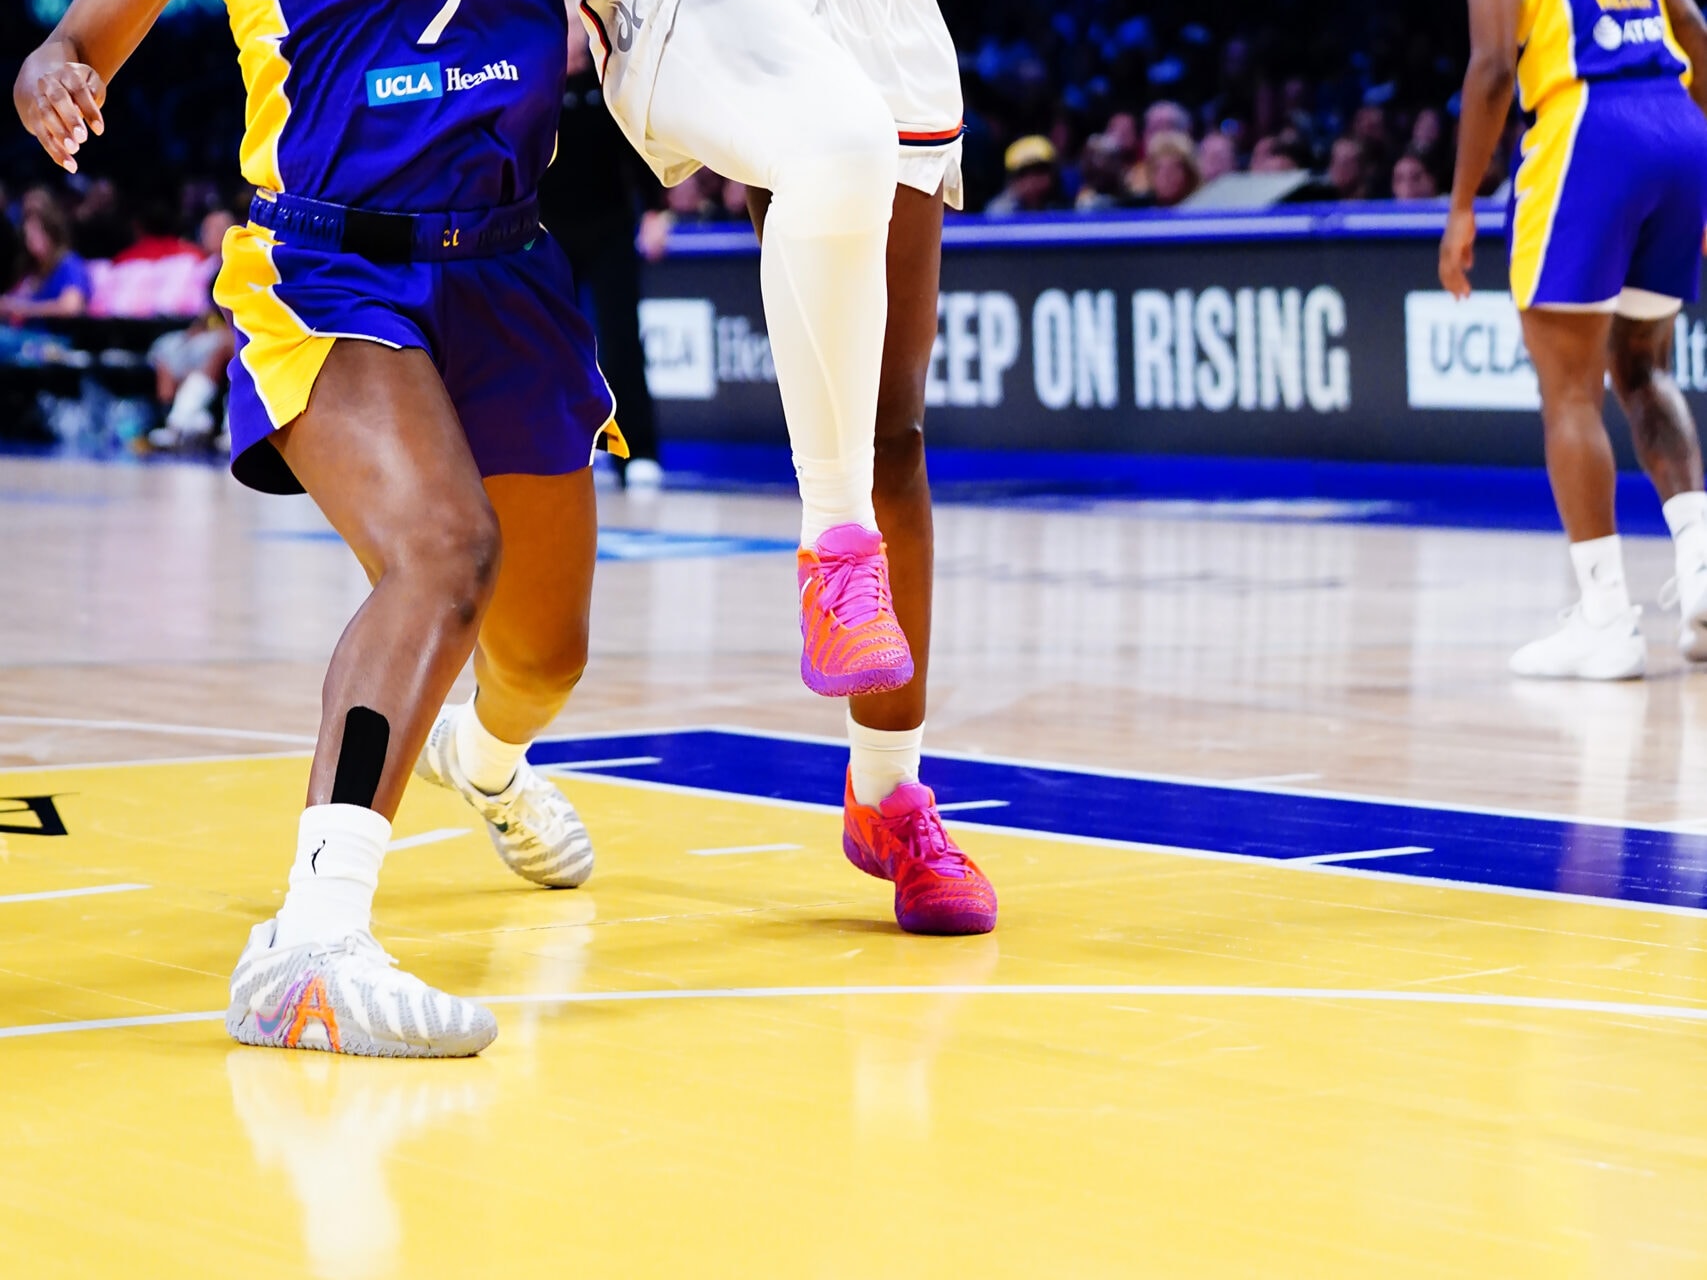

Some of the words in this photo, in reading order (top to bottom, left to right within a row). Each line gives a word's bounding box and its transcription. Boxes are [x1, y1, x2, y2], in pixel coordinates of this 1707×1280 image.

[375, 72, 433, 98] UCLA
[445, 60, 519, 91] Health
[924, 290, 1020, 408] EEP
[1032, 288, 1118, 410] ON
[1131, 285, 1351, 413] RISING
